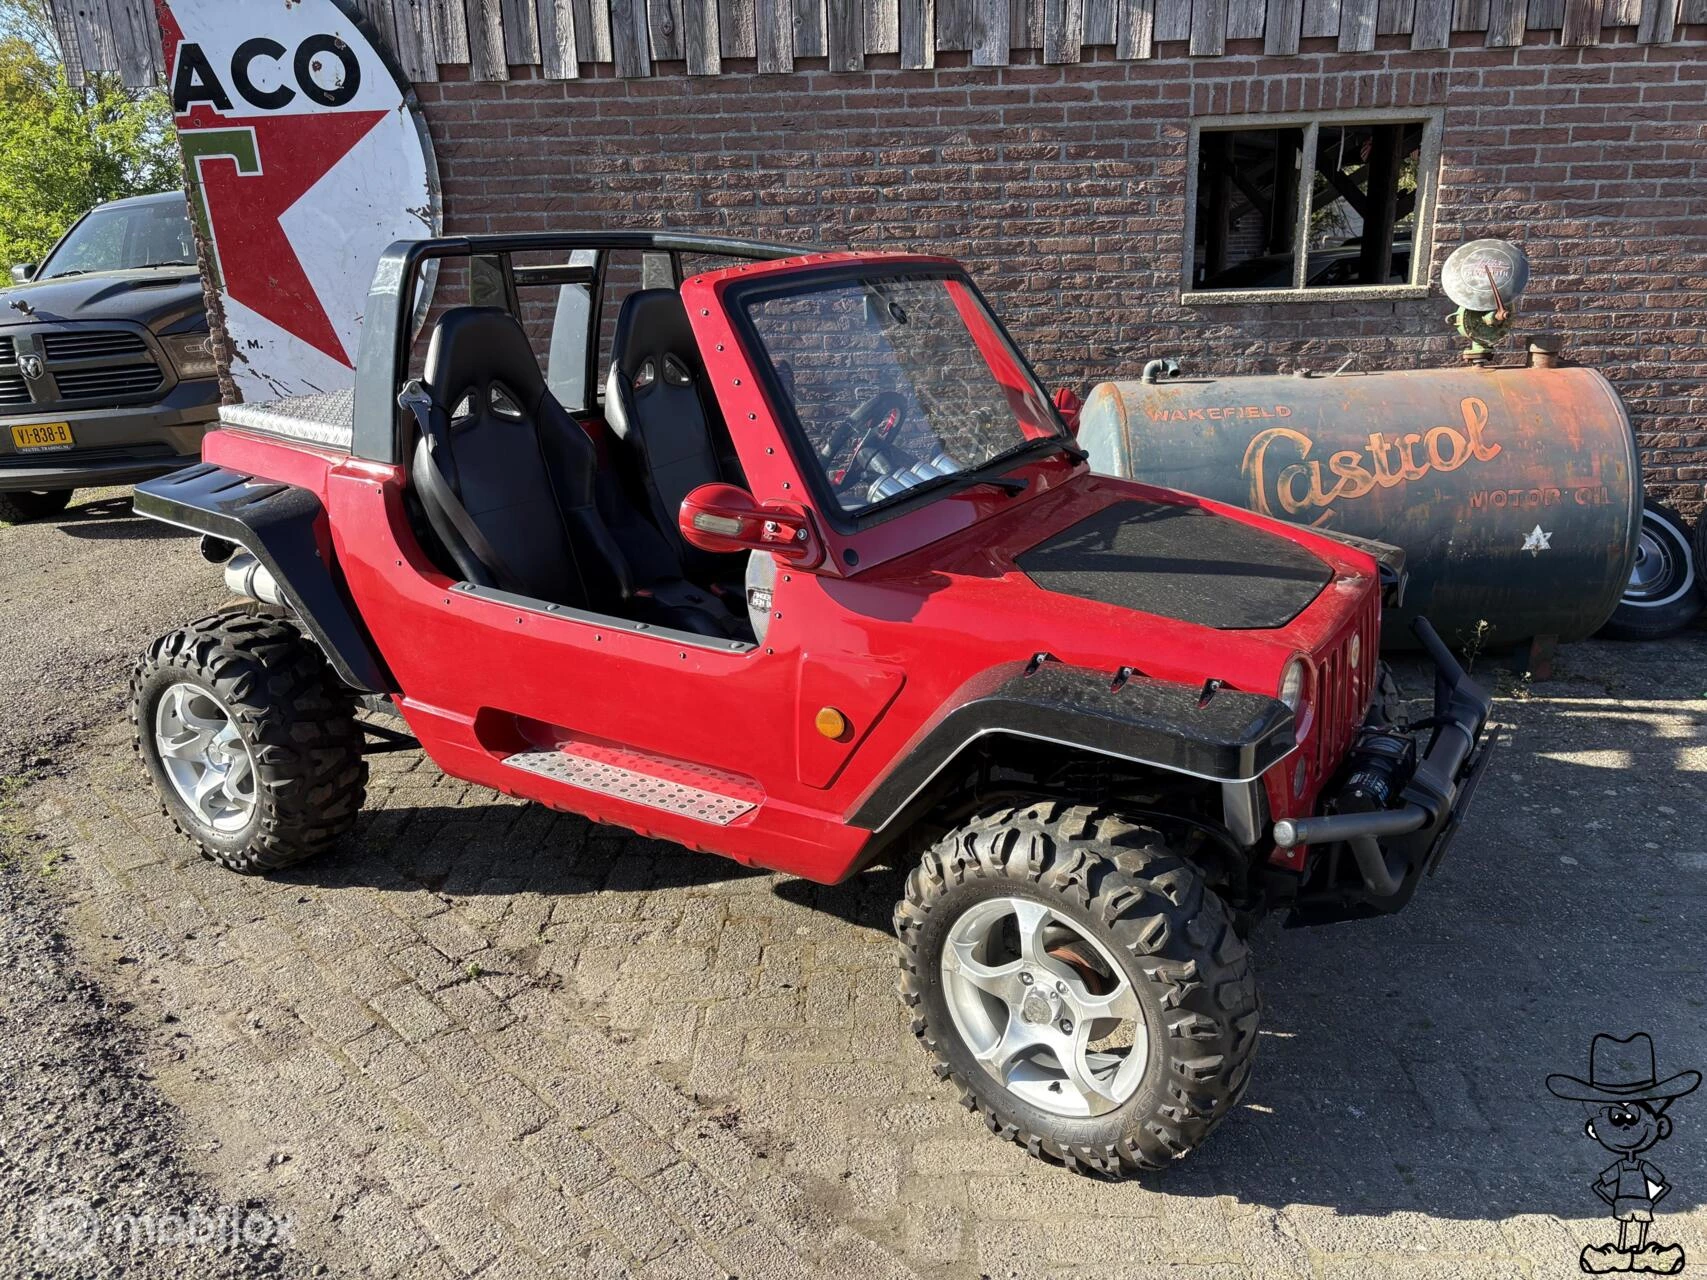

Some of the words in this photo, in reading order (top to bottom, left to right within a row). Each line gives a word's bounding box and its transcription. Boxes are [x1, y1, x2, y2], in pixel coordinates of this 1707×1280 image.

[174, 34, 361, 112] ACO
[1147, 404, 1293, 422] WAKEFIELD
[17, 426, 67, 444] VJ-838-B
[1240, 396, 1502, 521] Castrol
[1470, 487, 1562, 509] MOTOR
[1574, 487, 1614, 506] OIL
